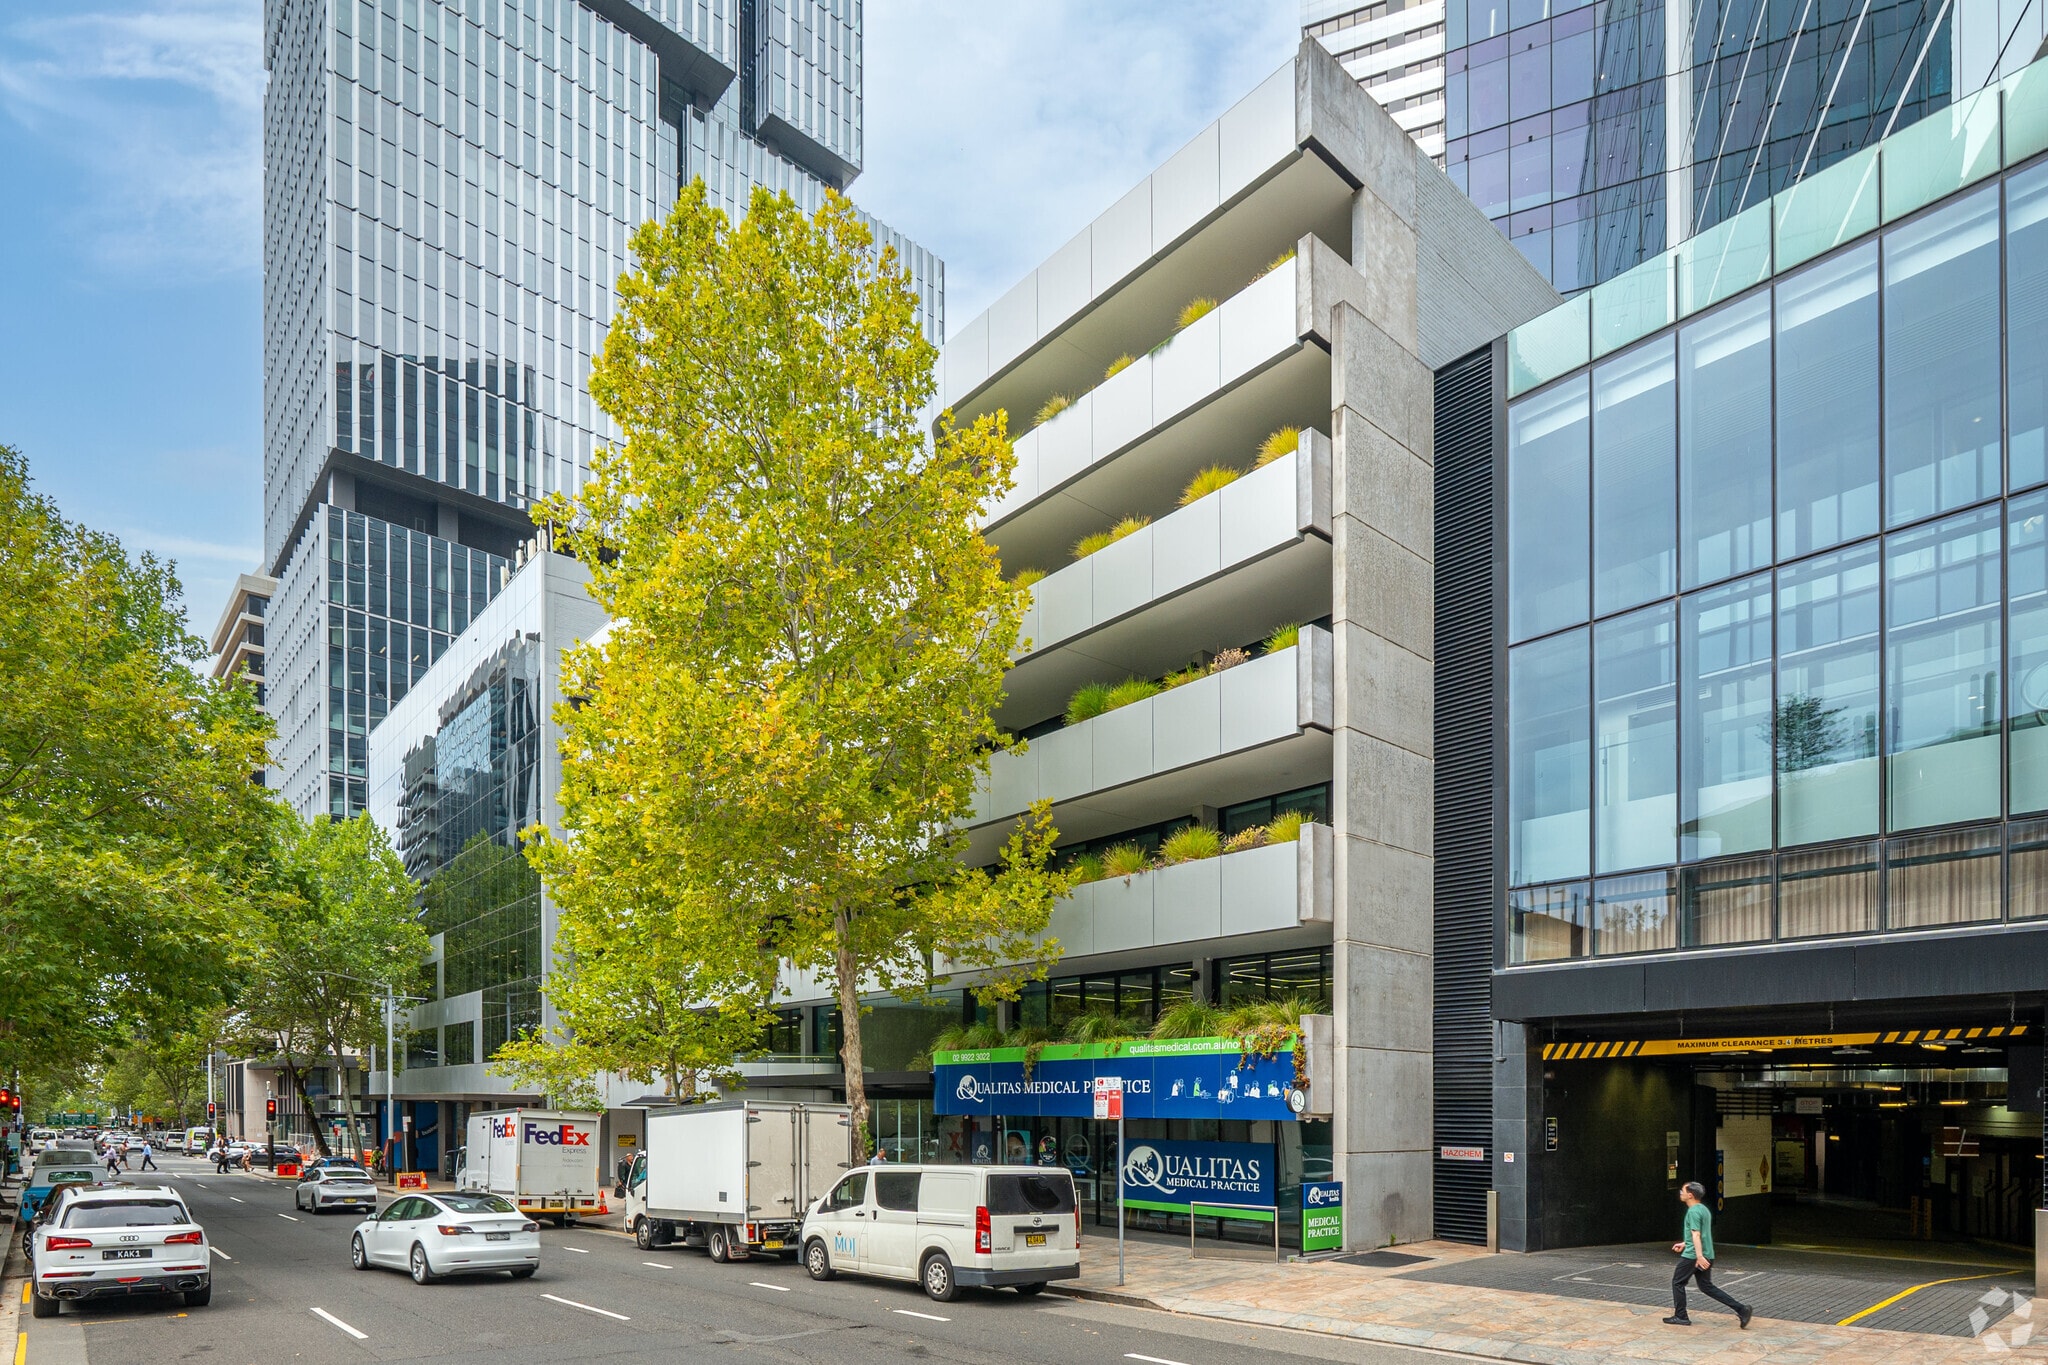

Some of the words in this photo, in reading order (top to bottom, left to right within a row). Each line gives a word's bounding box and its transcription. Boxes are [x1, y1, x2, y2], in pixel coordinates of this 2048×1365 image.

[1677, 1041, 1720, 1049] MAXIMUM
[1721, 1039, 1775, 1048] CLEARANCE
[1794, 1036, 1834, 1046] METRES
[952, 1053, 960, 1062] 02
[960, 1053, 975, 1062] 9922
[975, 1052, 991, 1061] 3022
[956, 1074, 1021, 1103] QUALITAS
[1024, 1080, 1080, 1095] MEDICAL
[492, 1117, 516, 1138] FedEx
[524, 1123, 590, 1146] FedEx
[562, 1146, 587, 1154] Express
[1442, 1148, 1482, 1158] HAZCHEM
[1123, 1145, 1261, 1195] QUALITAS
[1166, 1177, 1209, 1189] MEDICAL
[1211, 1181, 1261, 1193] PRACTICE
[1307, 1186, 1340, 1205] QUALITAS
[1308, 1215, 1340, 1228] MEDICAL
[1307, 1226, 1340, 1239] PRACTICE
[117, 1249, 141, 1259] KAK1
[834, 1236, 856, 1258] MOJ
